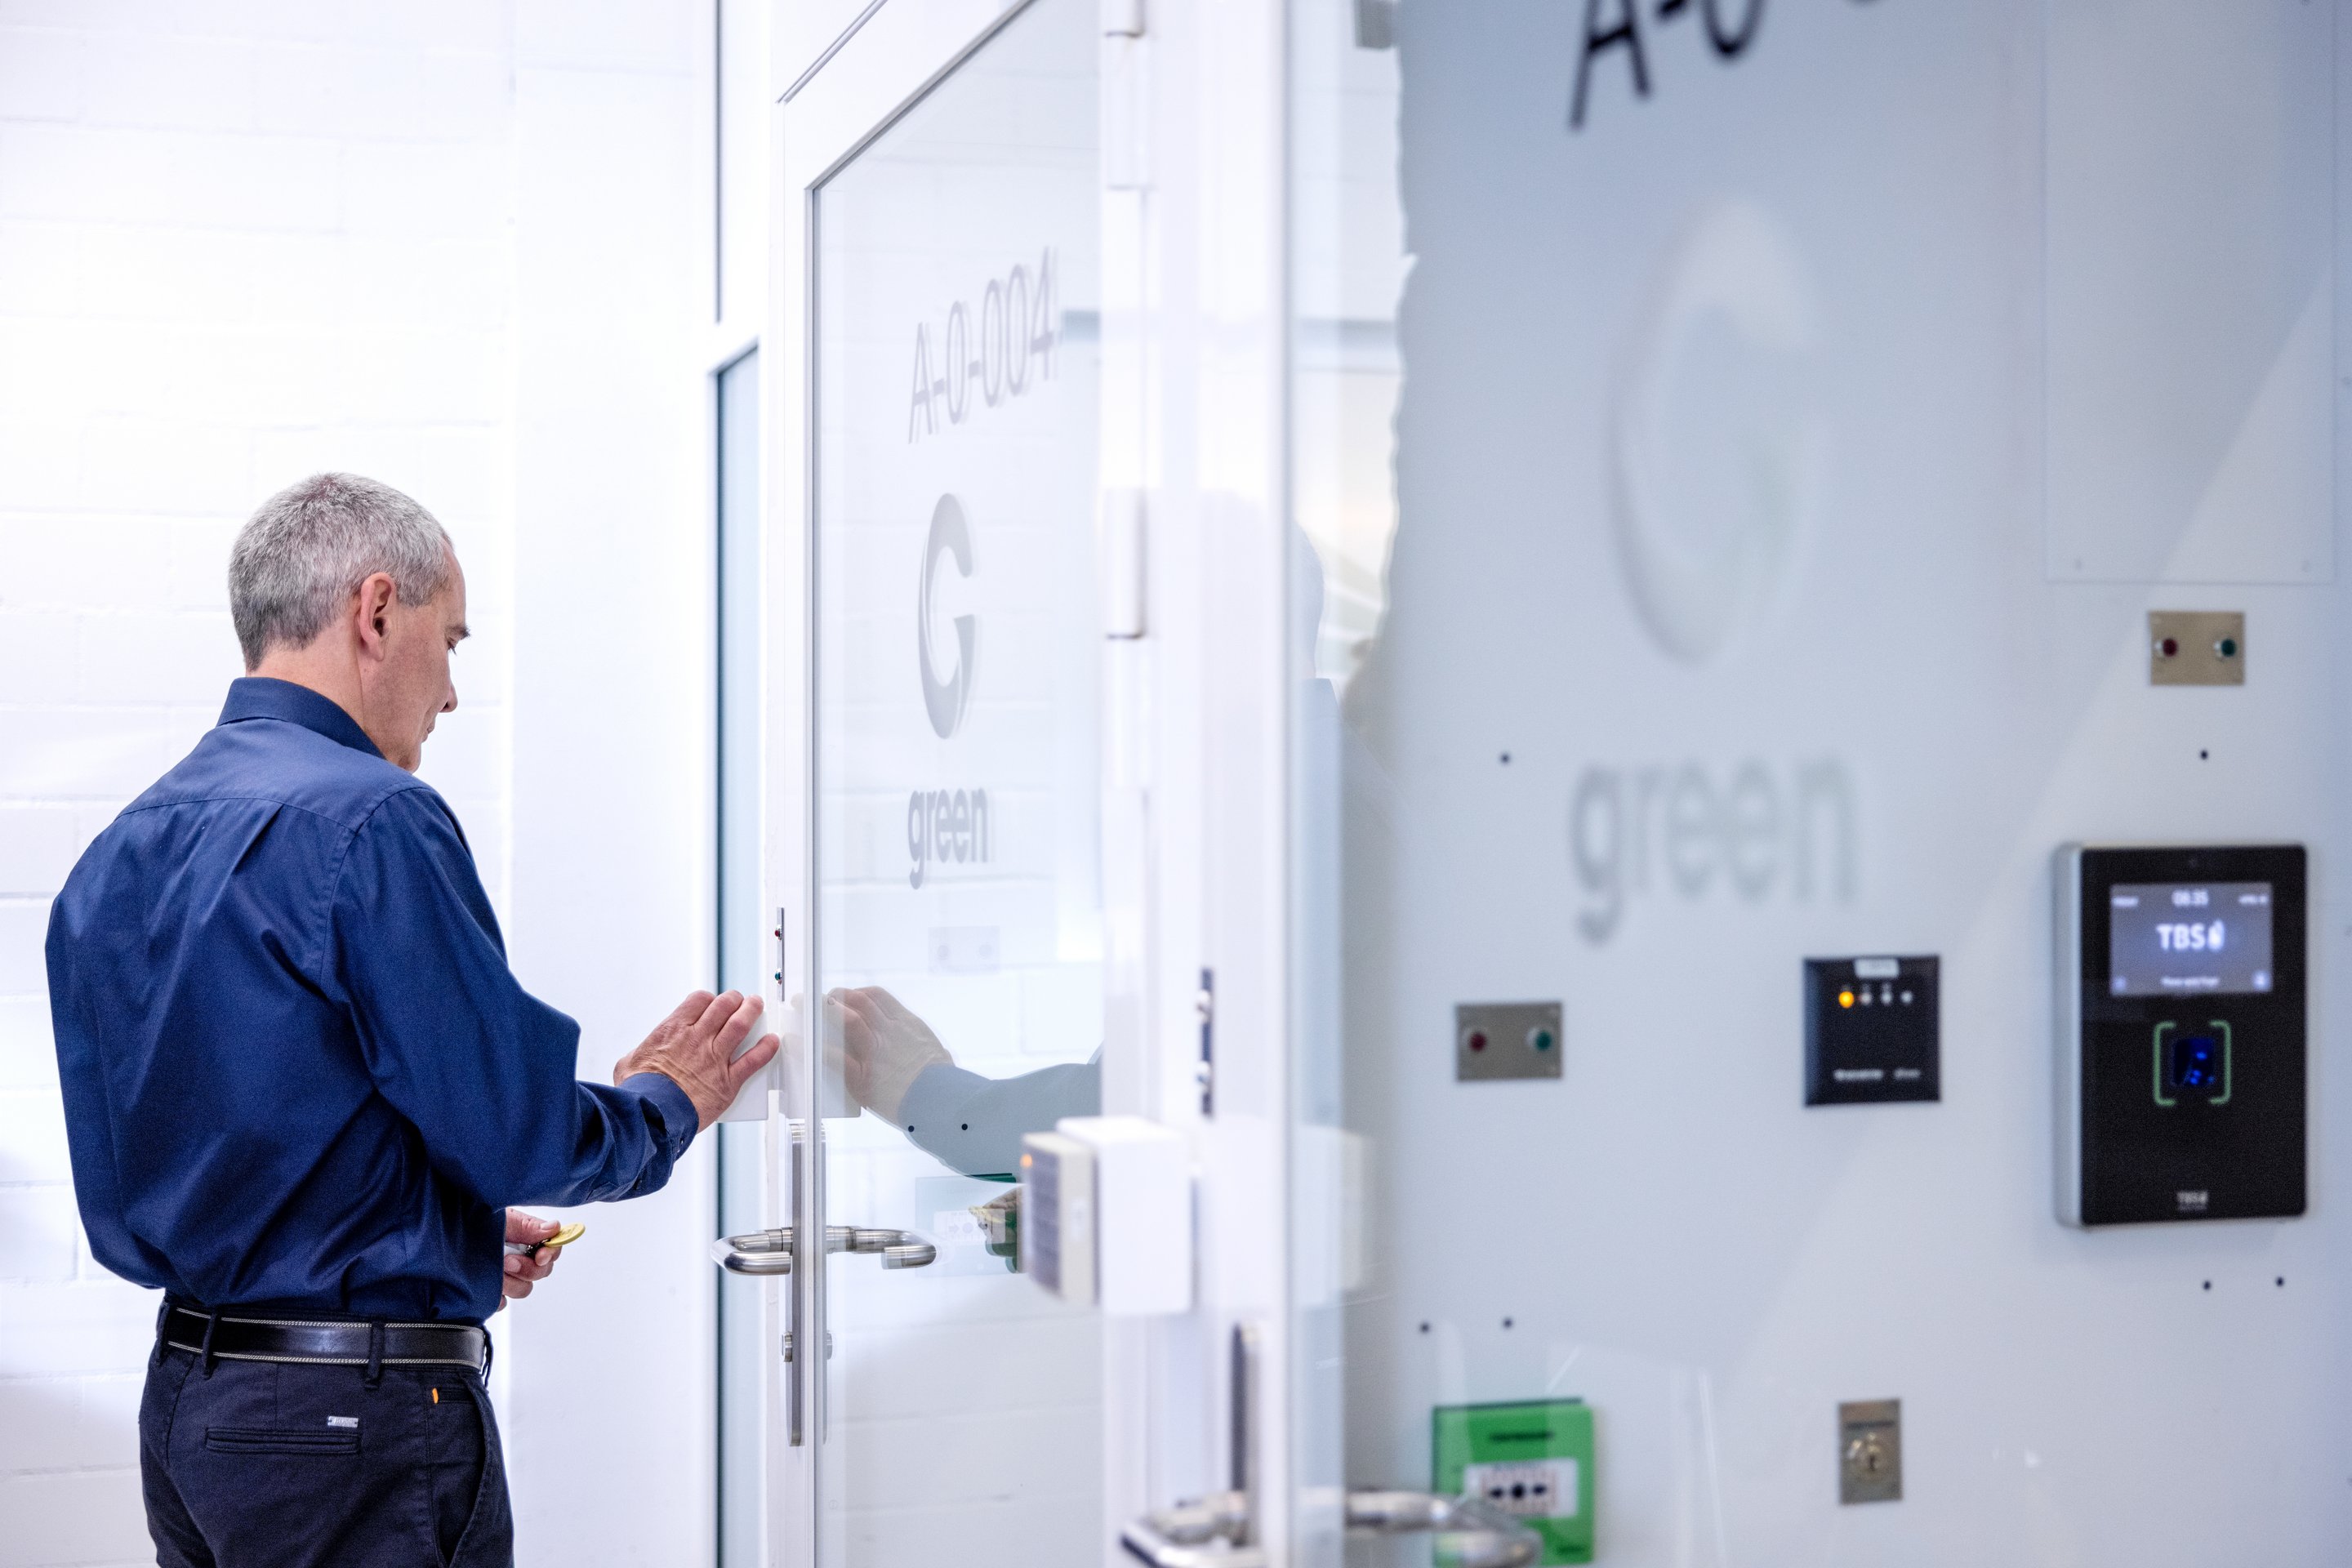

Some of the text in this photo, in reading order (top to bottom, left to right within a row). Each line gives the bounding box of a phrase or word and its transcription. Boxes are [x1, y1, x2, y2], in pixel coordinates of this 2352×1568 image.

[908, 245, 1054, 443] A-0-004
[908, 785, 988, 890] green
[1567, 756, 1860, 948] green
[2156, 921, 2207, 952] TBS
